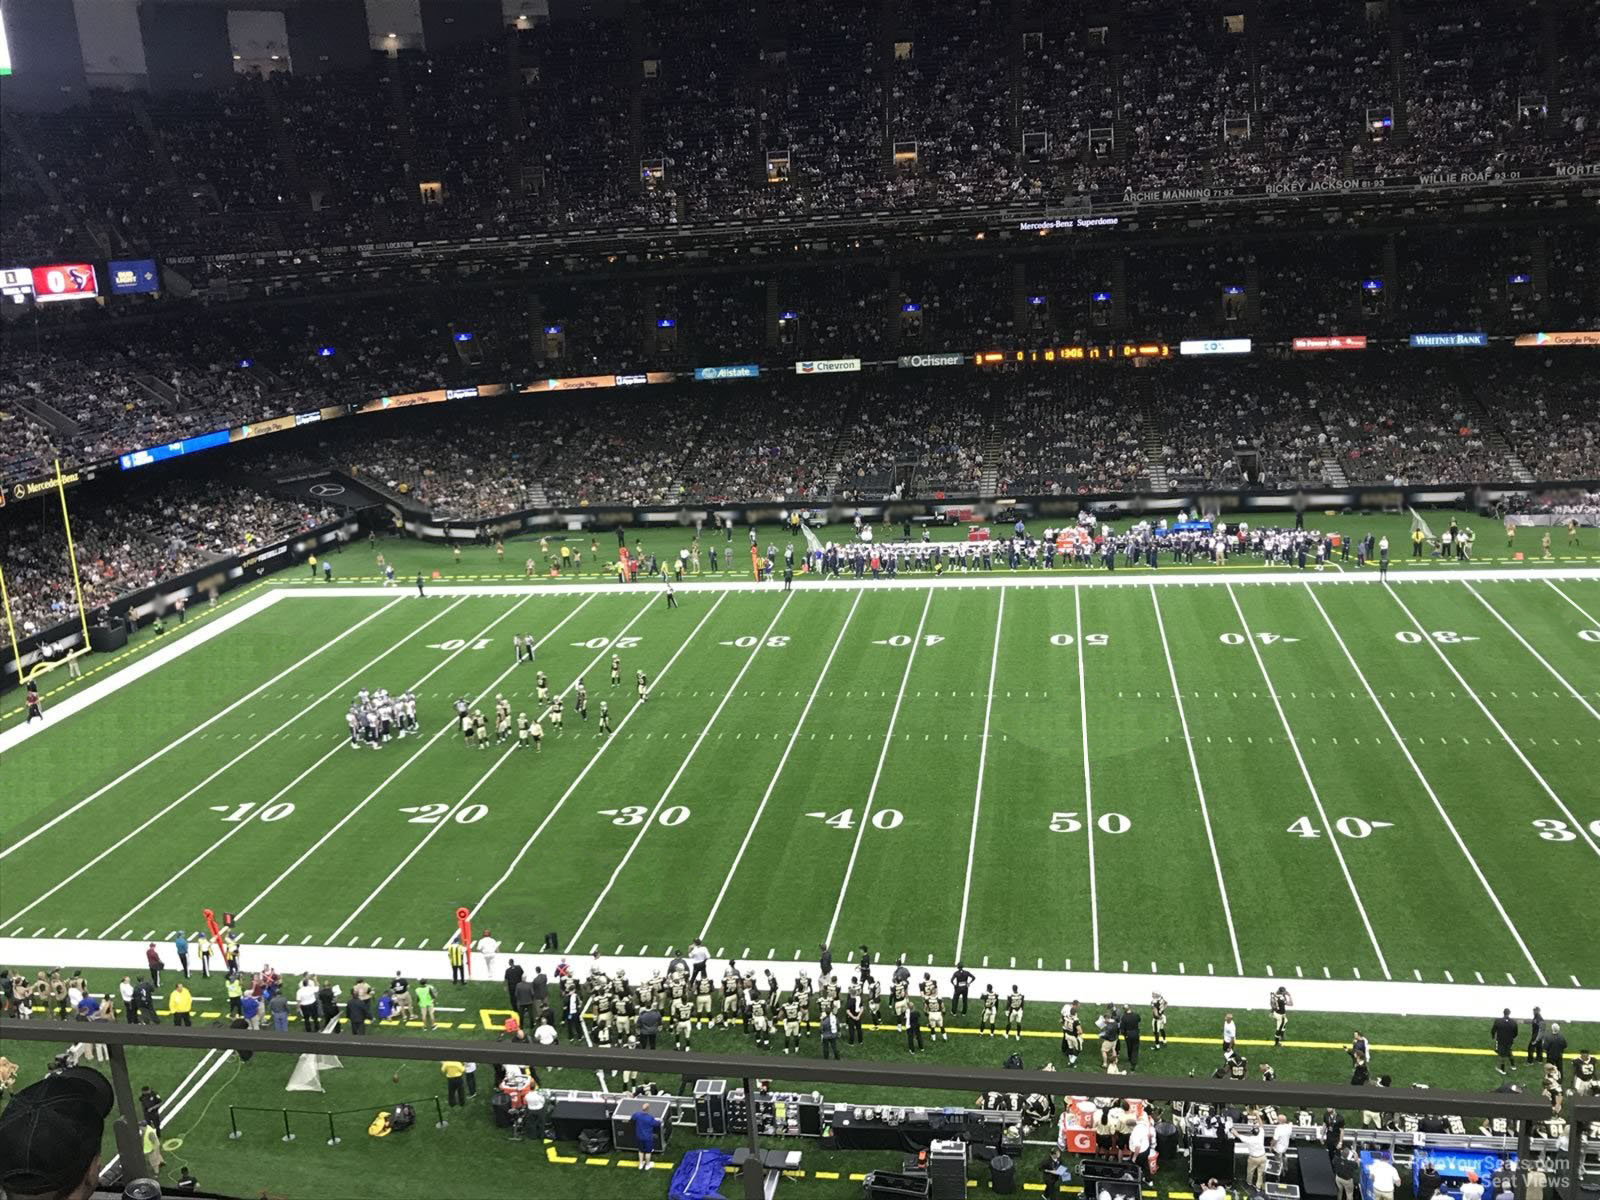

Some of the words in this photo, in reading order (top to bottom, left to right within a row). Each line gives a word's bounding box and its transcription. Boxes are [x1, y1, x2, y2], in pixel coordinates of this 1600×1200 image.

[1419, 173, 1456, 184] WILLIE
[1460, 171, 1491, 182] ROAF
[1265, 182, 1305, 193] RICKEY
[1307, 180, 1359, 191] JACKSON
[1123, 191, 1160, 202] ARCHIE
[1162, 188, 1211, 199] MANNING
[1020, 219, 1073, 230] Mercedes-Benz
[1077, 217, 1118, 228] Superdome
[386, 241, 414, 249] LOCATION
[46, 271, 65, 293] 0
[1416, 335, 1456, 345] WHITNEY
[1456, 335, 1481, 344] BANK
[1555, 336, 1582, 344] Google
[1584, 336, 1600, 344] Play
[817, 361, 855, 371] Chevron
[911, 354, 959, 367] Ochsner
[717, 367, 750, 377] Allstate
[27, 473, 79, 494] MercedesBenz
[220, 802, 295, 822] 10
[407, 803, 488, 824] 20
[612, 805, 691, 826] 30
[825, 808, 904, 829] 40
[1049, 812, 1131, 834] 50
[1286, 816, 1372, 838] 40
[1074, 1133, 1090, 1149] G
